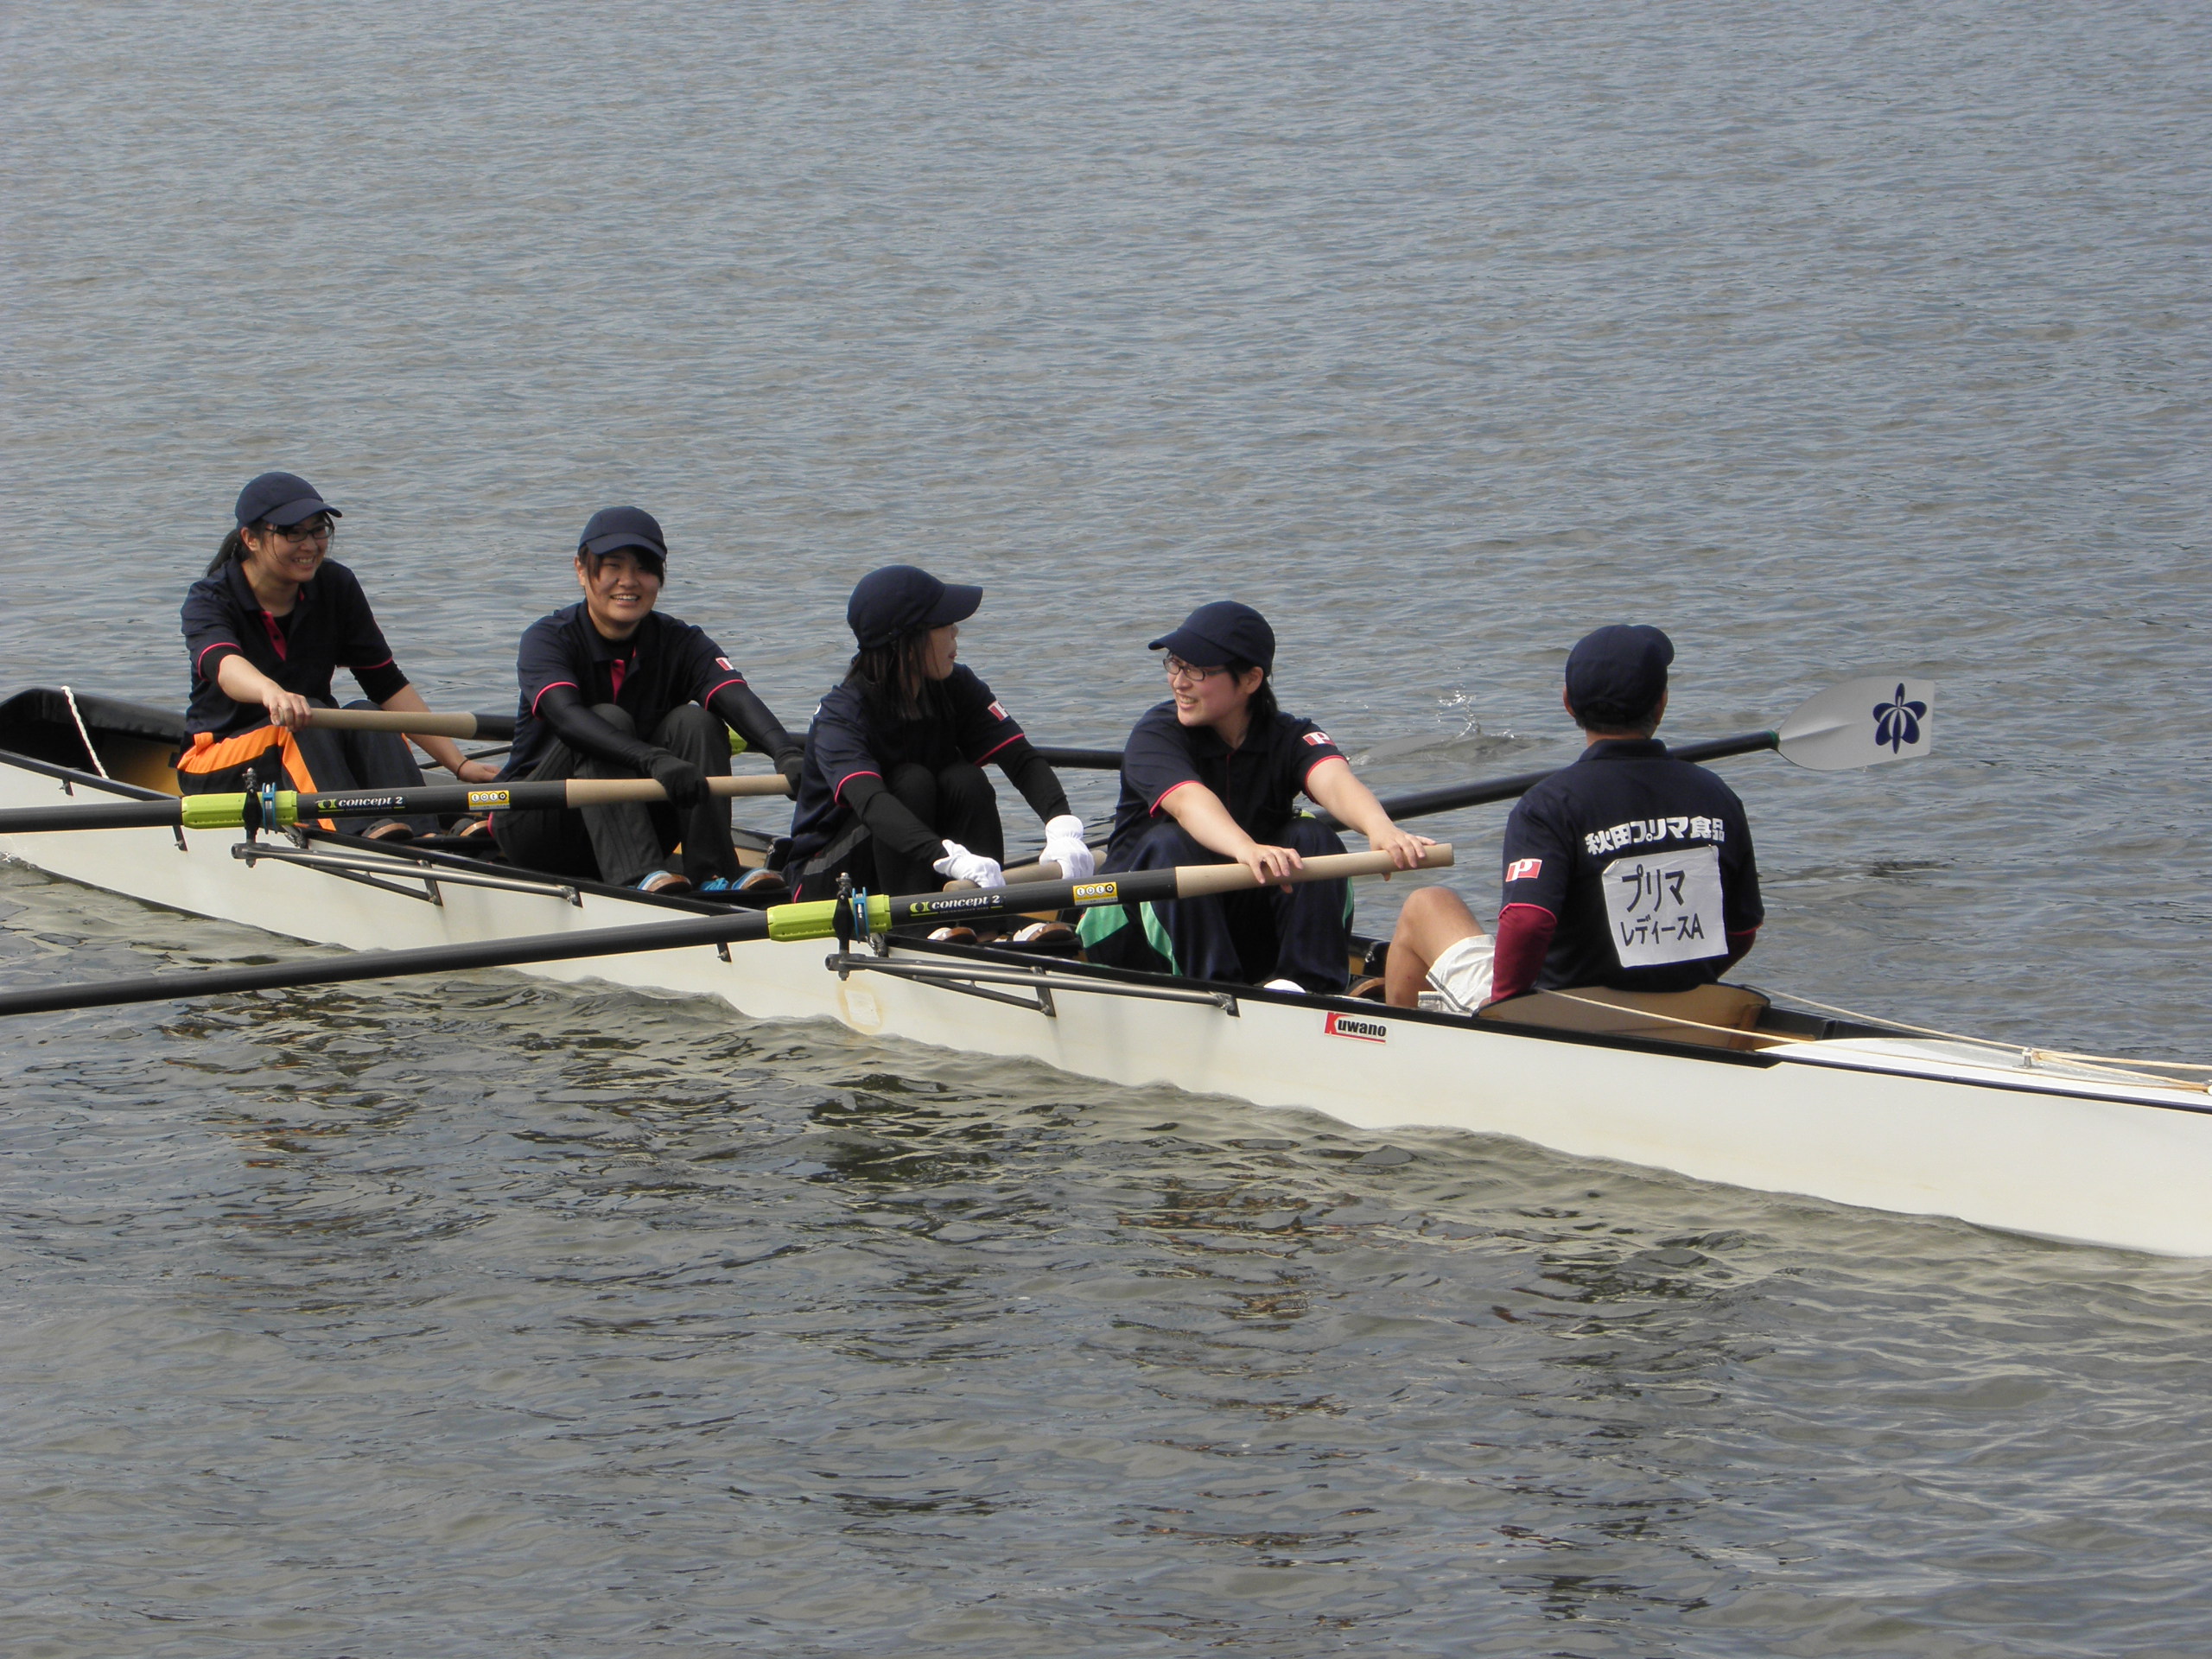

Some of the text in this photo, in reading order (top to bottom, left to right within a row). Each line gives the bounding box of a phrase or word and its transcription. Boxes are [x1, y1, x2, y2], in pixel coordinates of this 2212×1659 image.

[338, 796, 404, 807] concept 2
[471, 791, 507, 803] toto
[1584, 816, 1726, 855] 秋田プリマ食品
[1076, 883, 1115, 897] toto
[1621, 863, 1686, 913] プリマ
[931, 896, 988, 910] concept
[991, 894, 1001, 904] 2
[1620, 912, 1705, 947] レディースA
[1324, 1011, 1388, 1037] Kuwano
